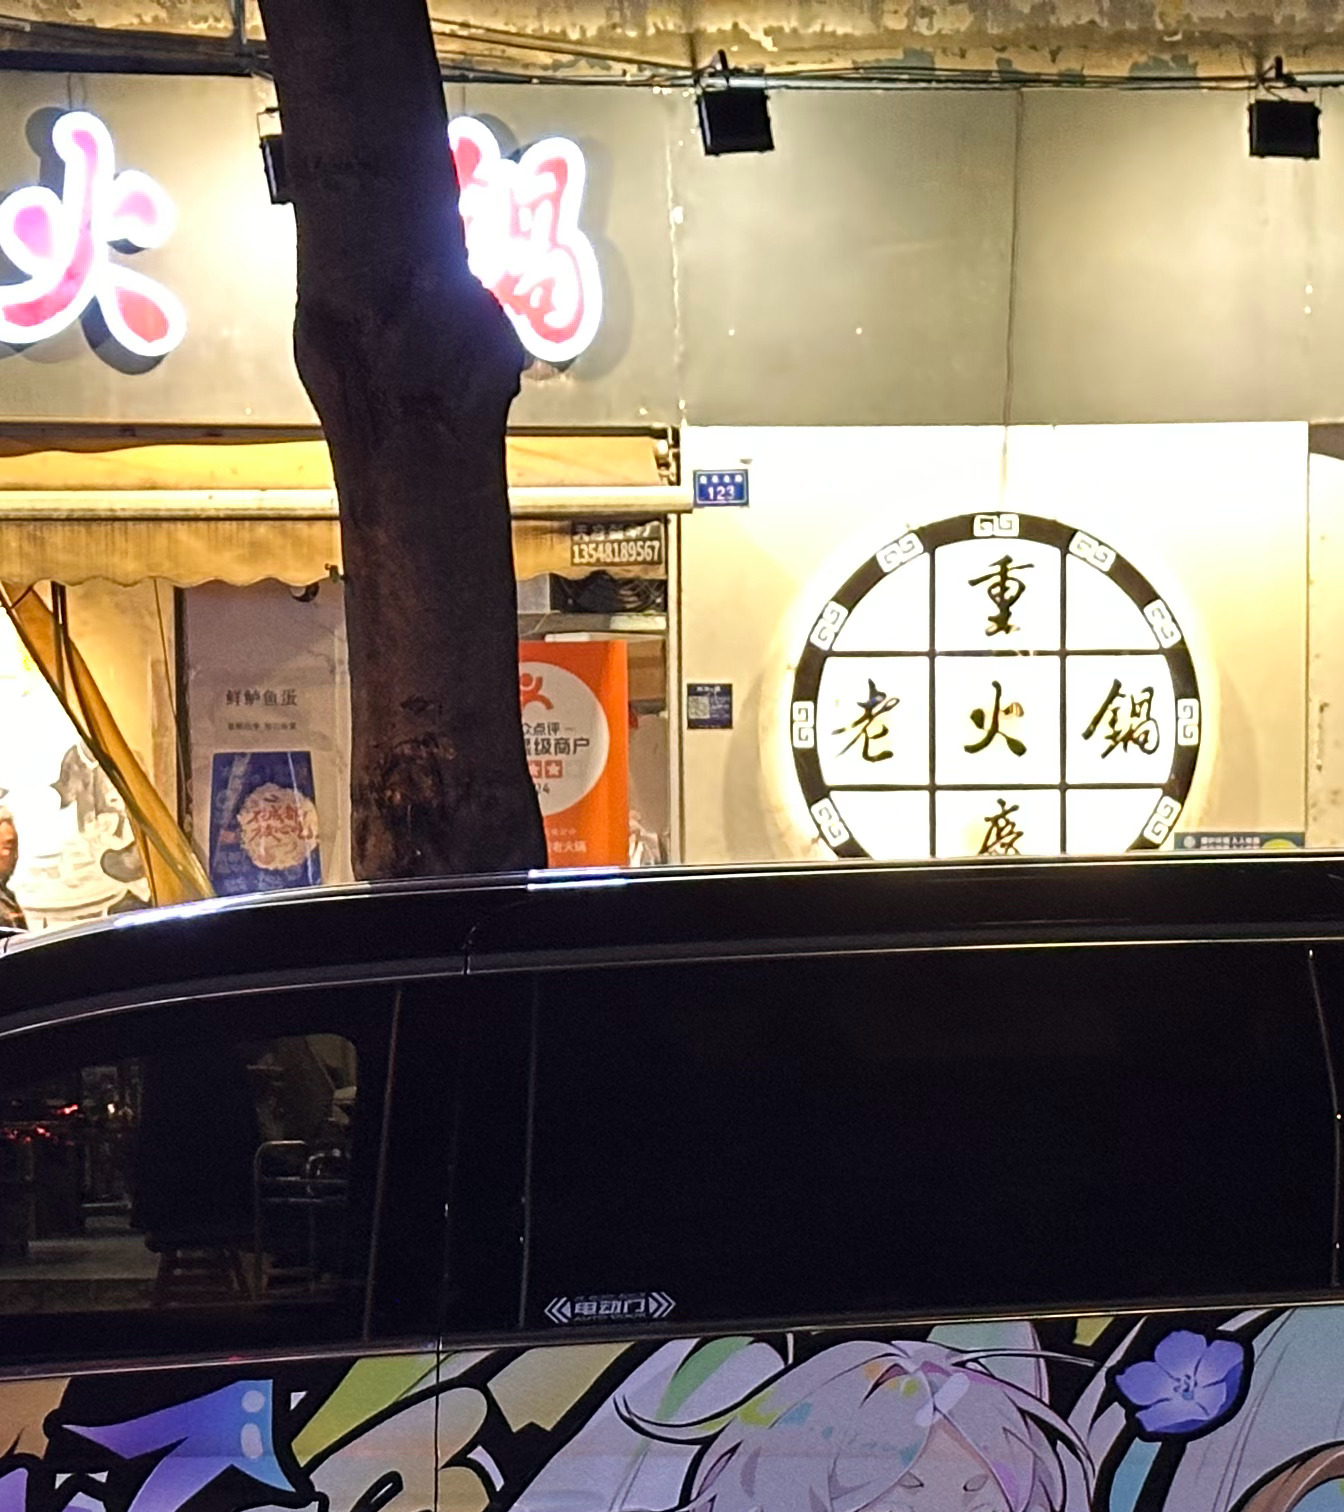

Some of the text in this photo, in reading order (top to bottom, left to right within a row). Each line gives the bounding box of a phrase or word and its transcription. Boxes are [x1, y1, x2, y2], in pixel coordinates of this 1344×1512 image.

[708, 485, 735, 500] 123
[573, 540, 660, 563] 13548189567
[968, 554, 1034, 637] 重
[574, 1299, 646, 1315] 电动门
